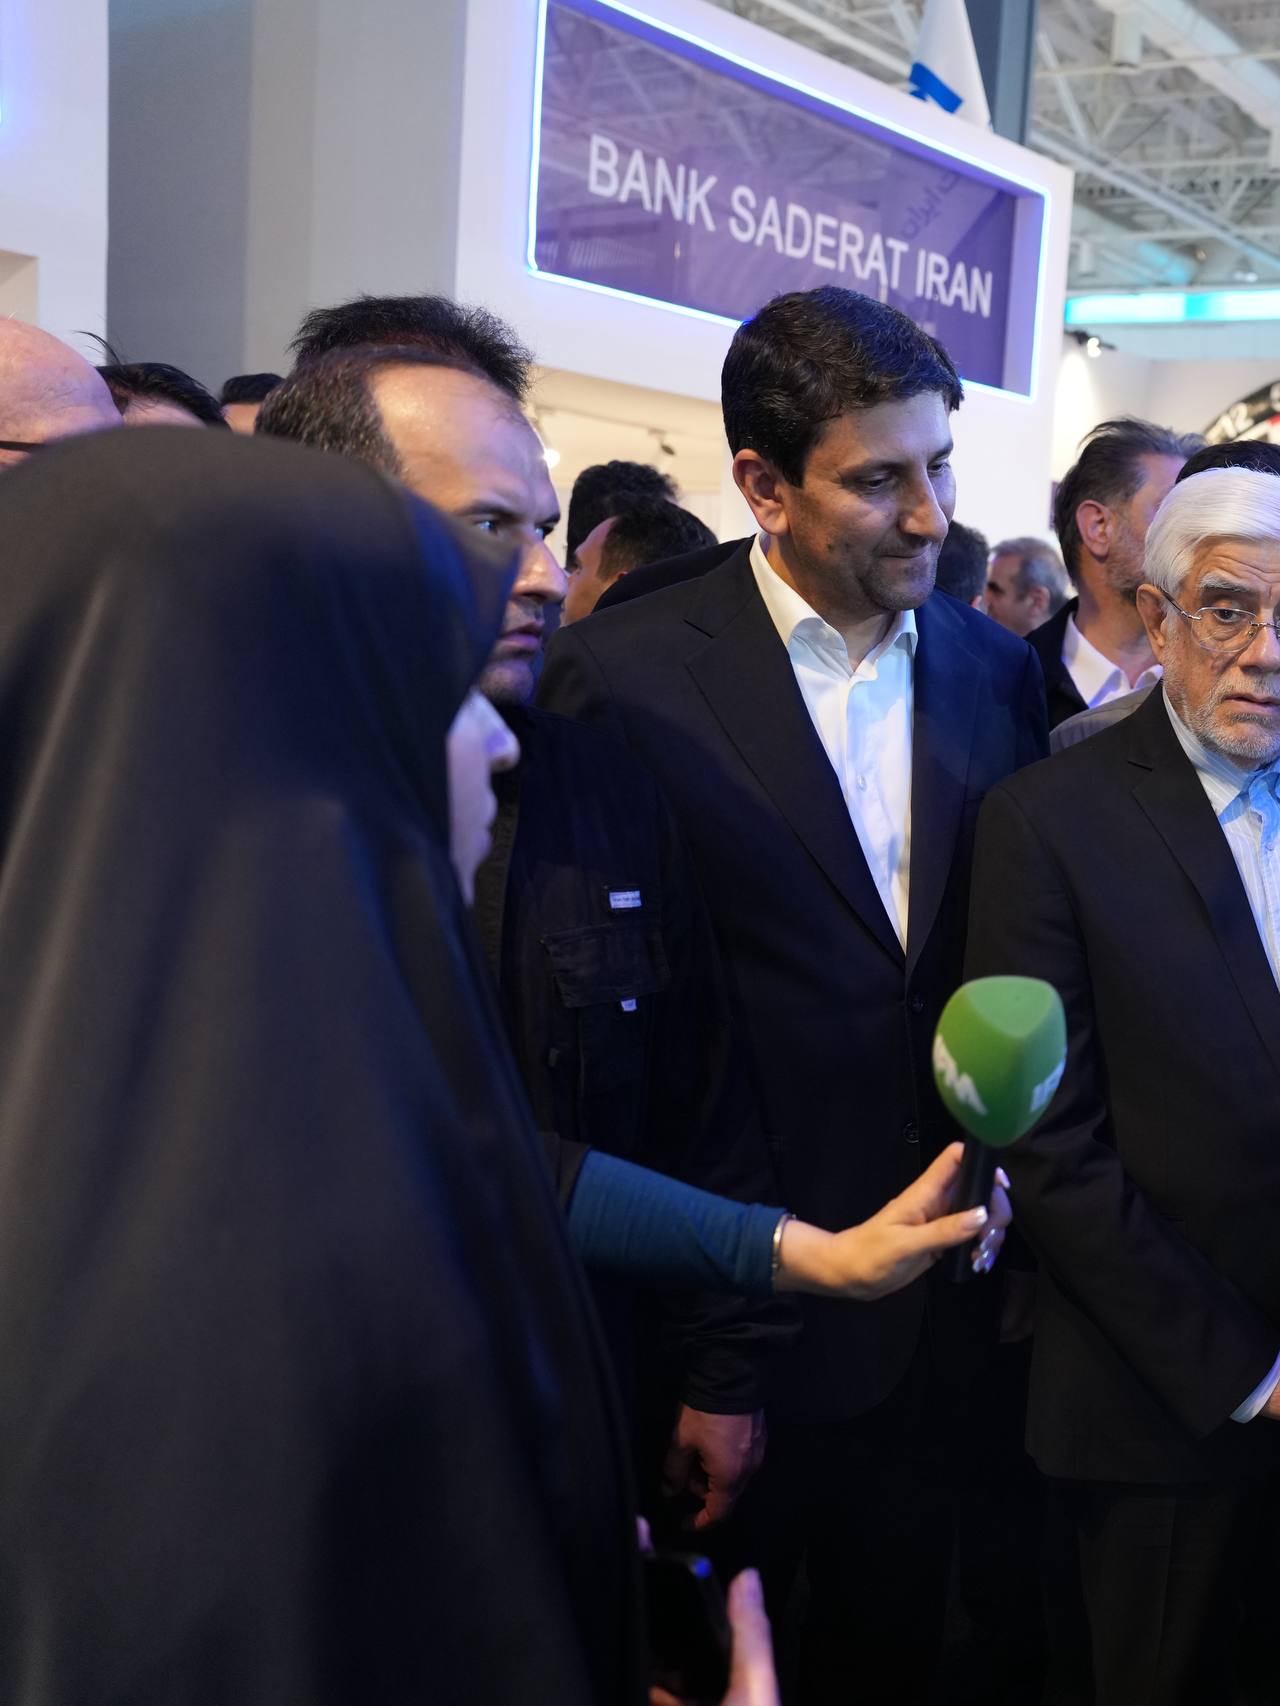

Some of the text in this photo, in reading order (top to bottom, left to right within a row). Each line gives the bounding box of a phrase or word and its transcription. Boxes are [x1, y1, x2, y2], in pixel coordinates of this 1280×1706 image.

[588, 134, 992, 318] BANK SADERAT IRAN
[1217, 402, 1254, 438] 12
